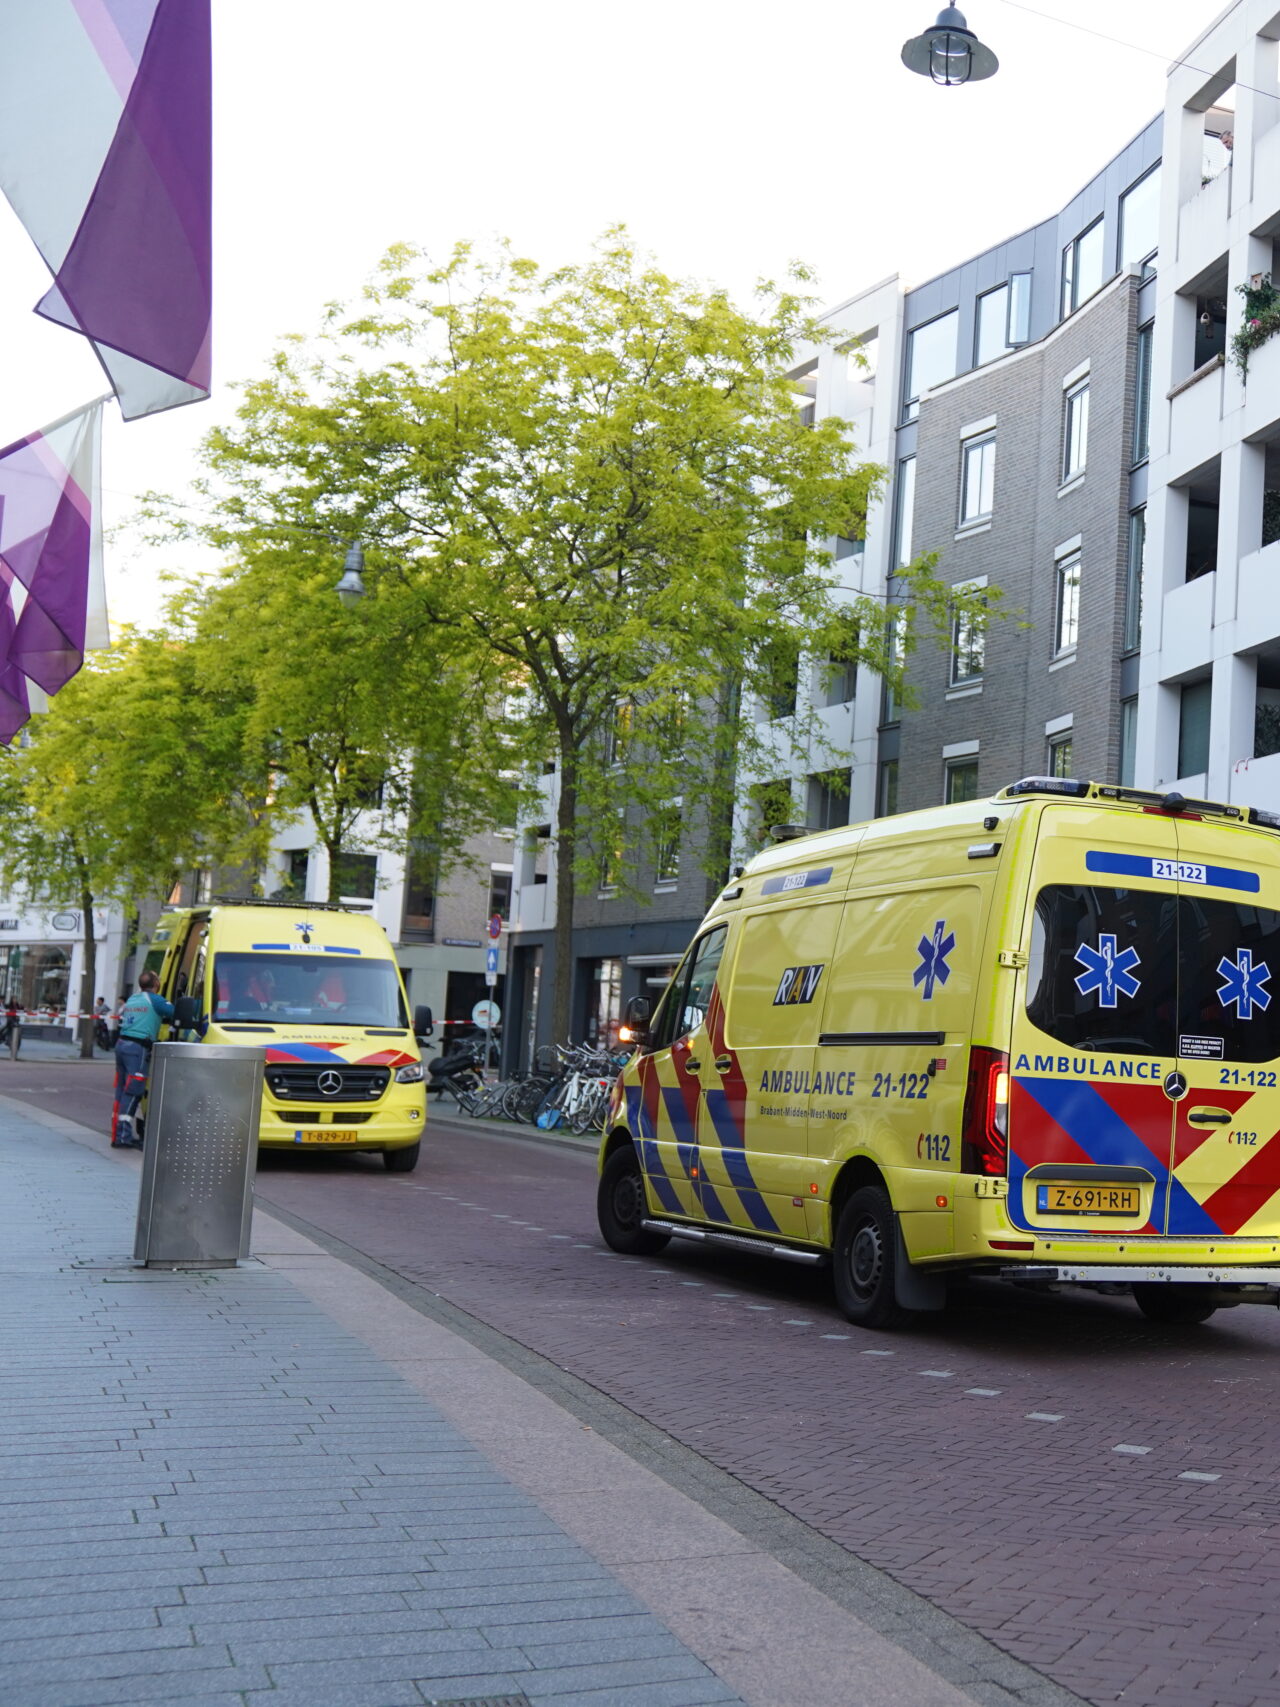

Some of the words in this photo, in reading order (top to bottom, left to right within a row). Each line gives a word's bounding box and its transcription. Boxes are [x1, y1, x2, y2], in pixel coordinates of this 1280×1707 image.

[1156, 862, 1203, 880] 21-122
[775, 965, 824, 1004] RAV
[1015, 1054, 1162, 1079] AMBULANCE
[1219, 1068, 1277, 1087] 21-122
[759, 1070, 856, 1096] AMBULANCE
[871, 1072, 930, 1099] 21-122
[760, 1105, 848, 1121] Brabant-Midden-West-Noord
[307, 1132, 352, 1142] T-829-JJ
[1056, 1190, 1131, 1209] Z-691-RH
